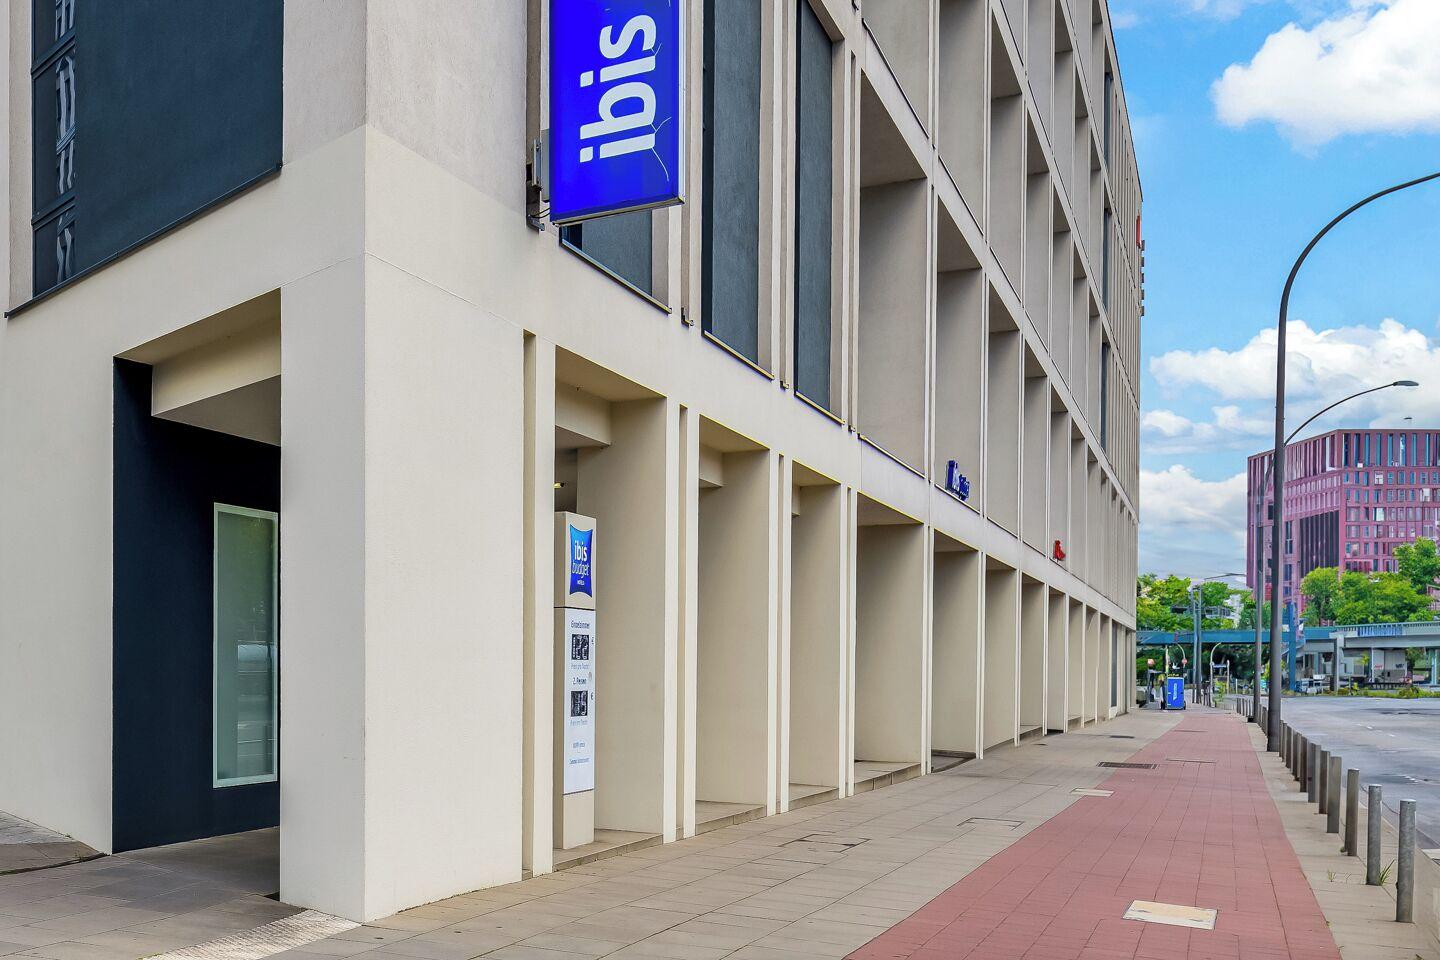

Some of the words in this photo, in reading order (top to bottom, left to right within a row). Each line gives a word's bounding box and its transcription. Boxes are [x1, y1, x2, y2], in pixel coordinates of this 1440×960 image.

[580, 14, 657, 163] ibis
[574, 539, 588, 562] ibis
[571, 558, 590, 579] budget
